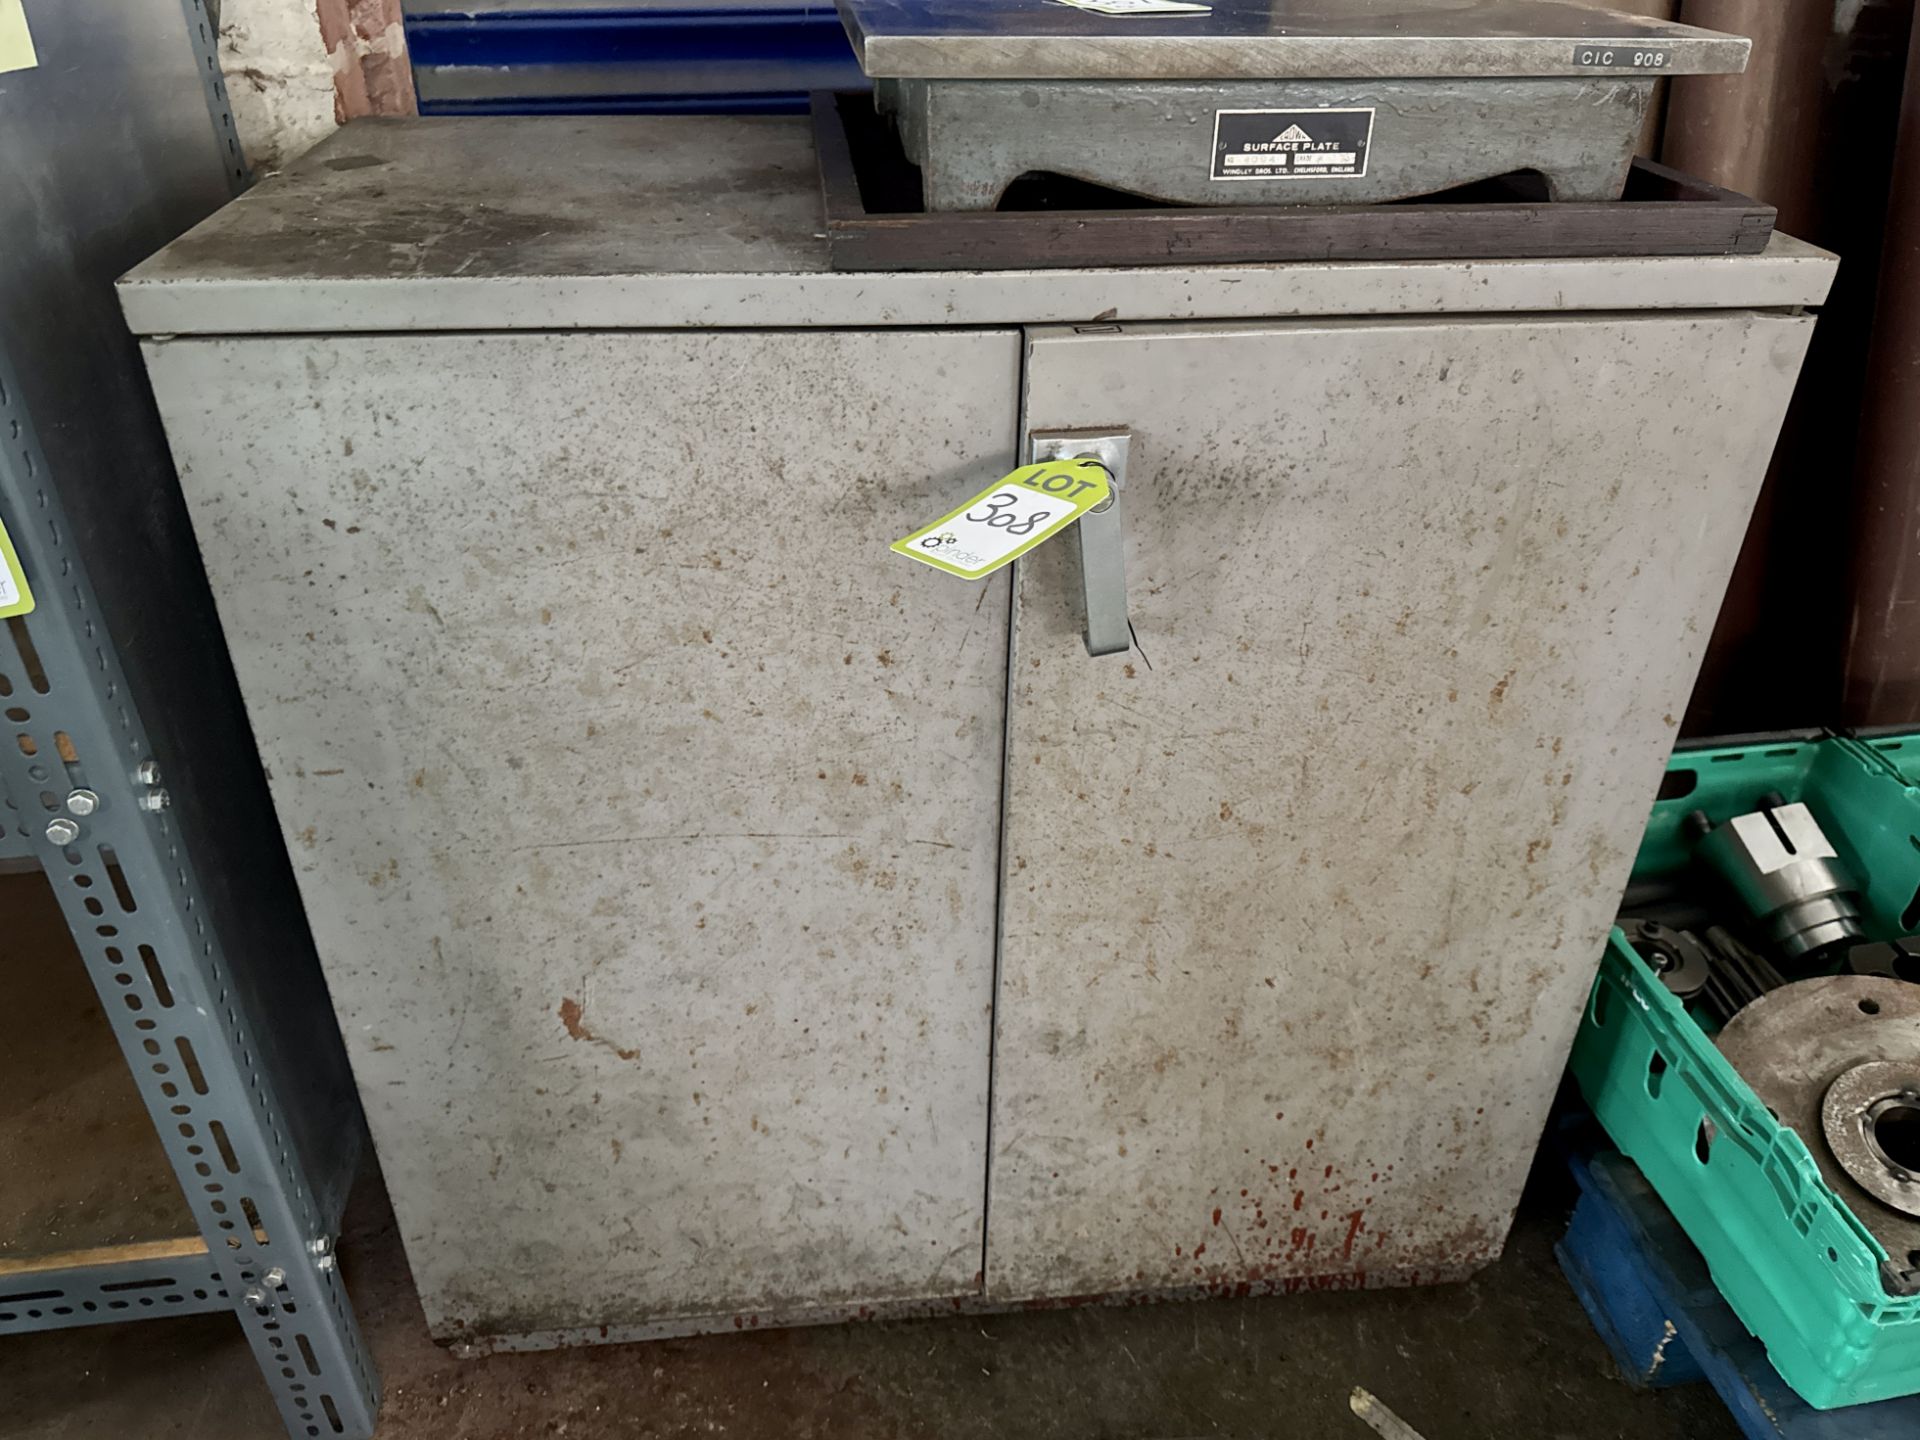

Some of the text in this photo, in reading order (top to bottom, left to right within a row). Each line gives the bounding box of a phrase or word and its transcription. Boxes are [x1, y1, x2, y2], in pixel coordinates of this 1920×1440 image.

[1581, 51, 1664, 66] CIC 908
[1243, 142, 1340, 152] SURFACE PLATE
[1023, 469, 1098, 498] LOT
[966, 493, 1051, 536] 308
